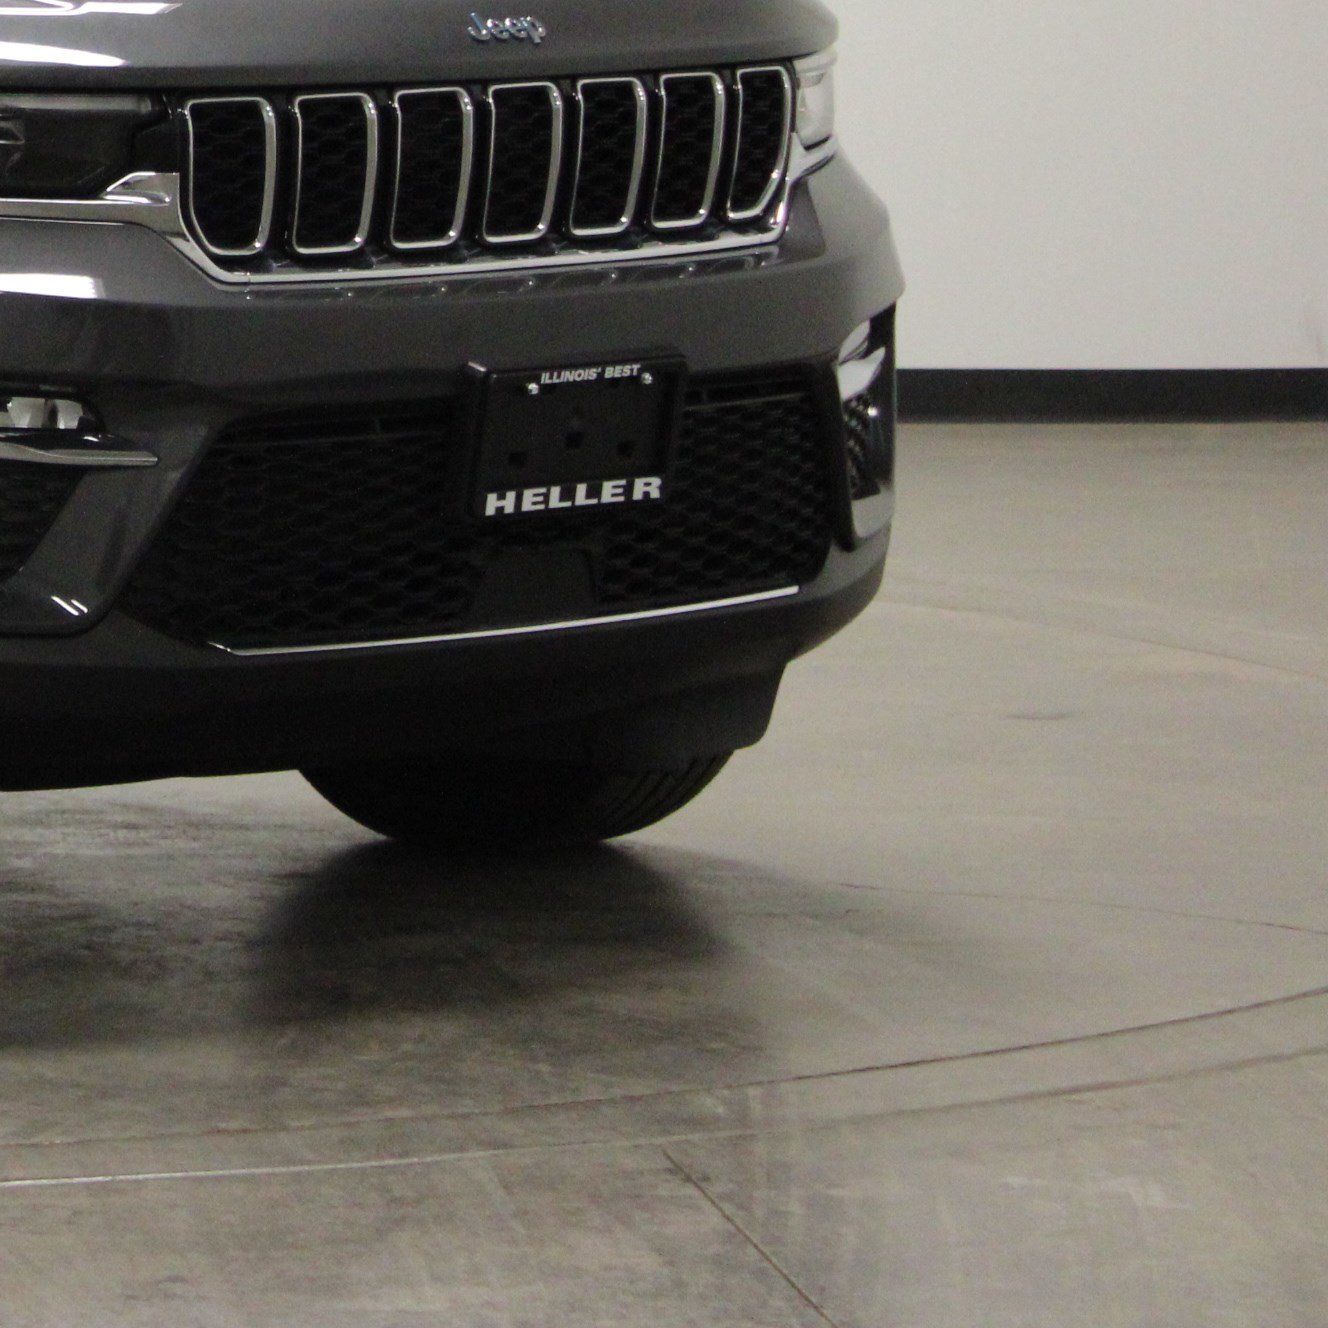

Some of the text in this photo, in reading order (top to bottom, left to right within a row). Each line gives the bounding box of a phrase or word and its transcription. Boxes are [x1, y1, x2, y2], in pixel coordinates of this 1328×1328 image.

[466, 12, 546, 44] Jeep
[540, 363, 641, 385] ILLINOIS' BEST
[485, 476, 663, 516] HELLER
